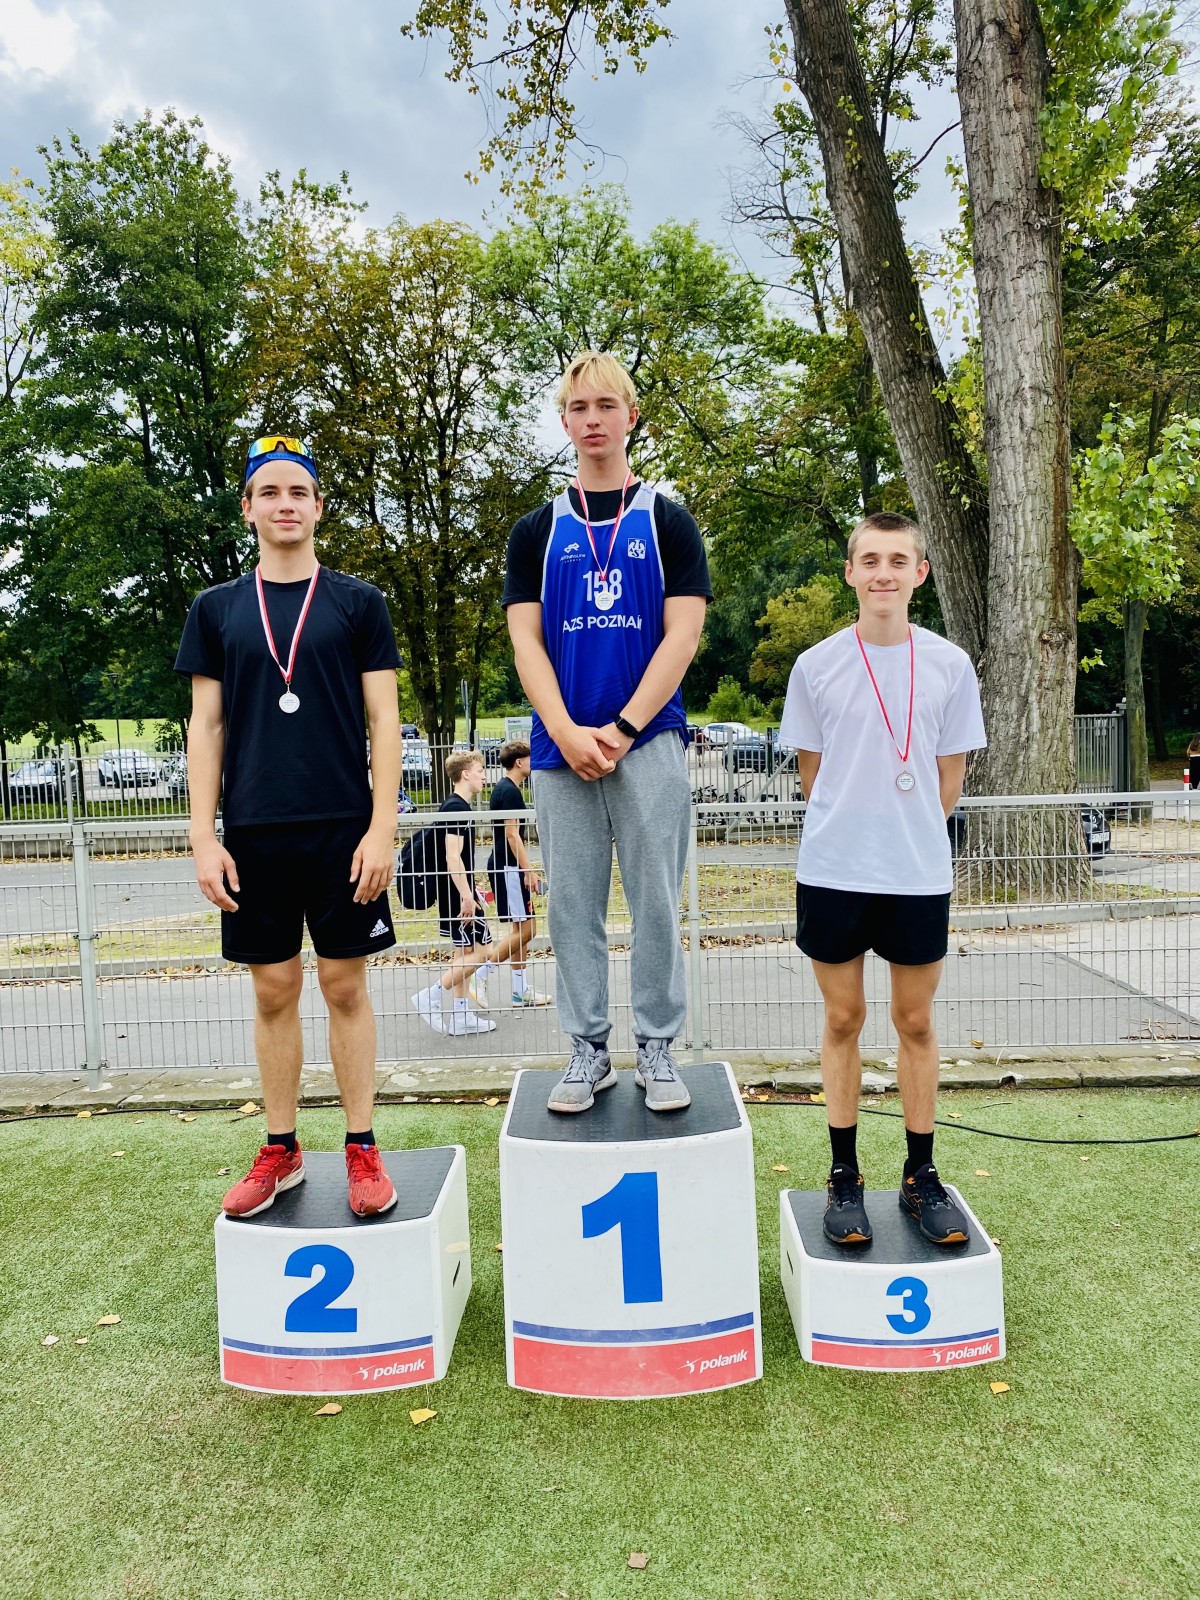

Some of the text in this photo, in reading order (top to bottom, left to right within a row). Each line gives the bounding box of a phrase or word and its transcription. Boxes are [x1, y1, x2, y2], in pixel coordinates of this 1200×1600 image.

[583, 568, 623, 602] 158
[562, 616, 584, 633] AZS
[581, 1171, 663, 1304] 1
[284, 1244, 358, 1333] 2
[885, 1276, 932, 1335] 3
[699, 1349, 748, 1374] polanik
[945, 1341, 993, 1364] polanik
[373, 1357, 426, 1381] polanik
